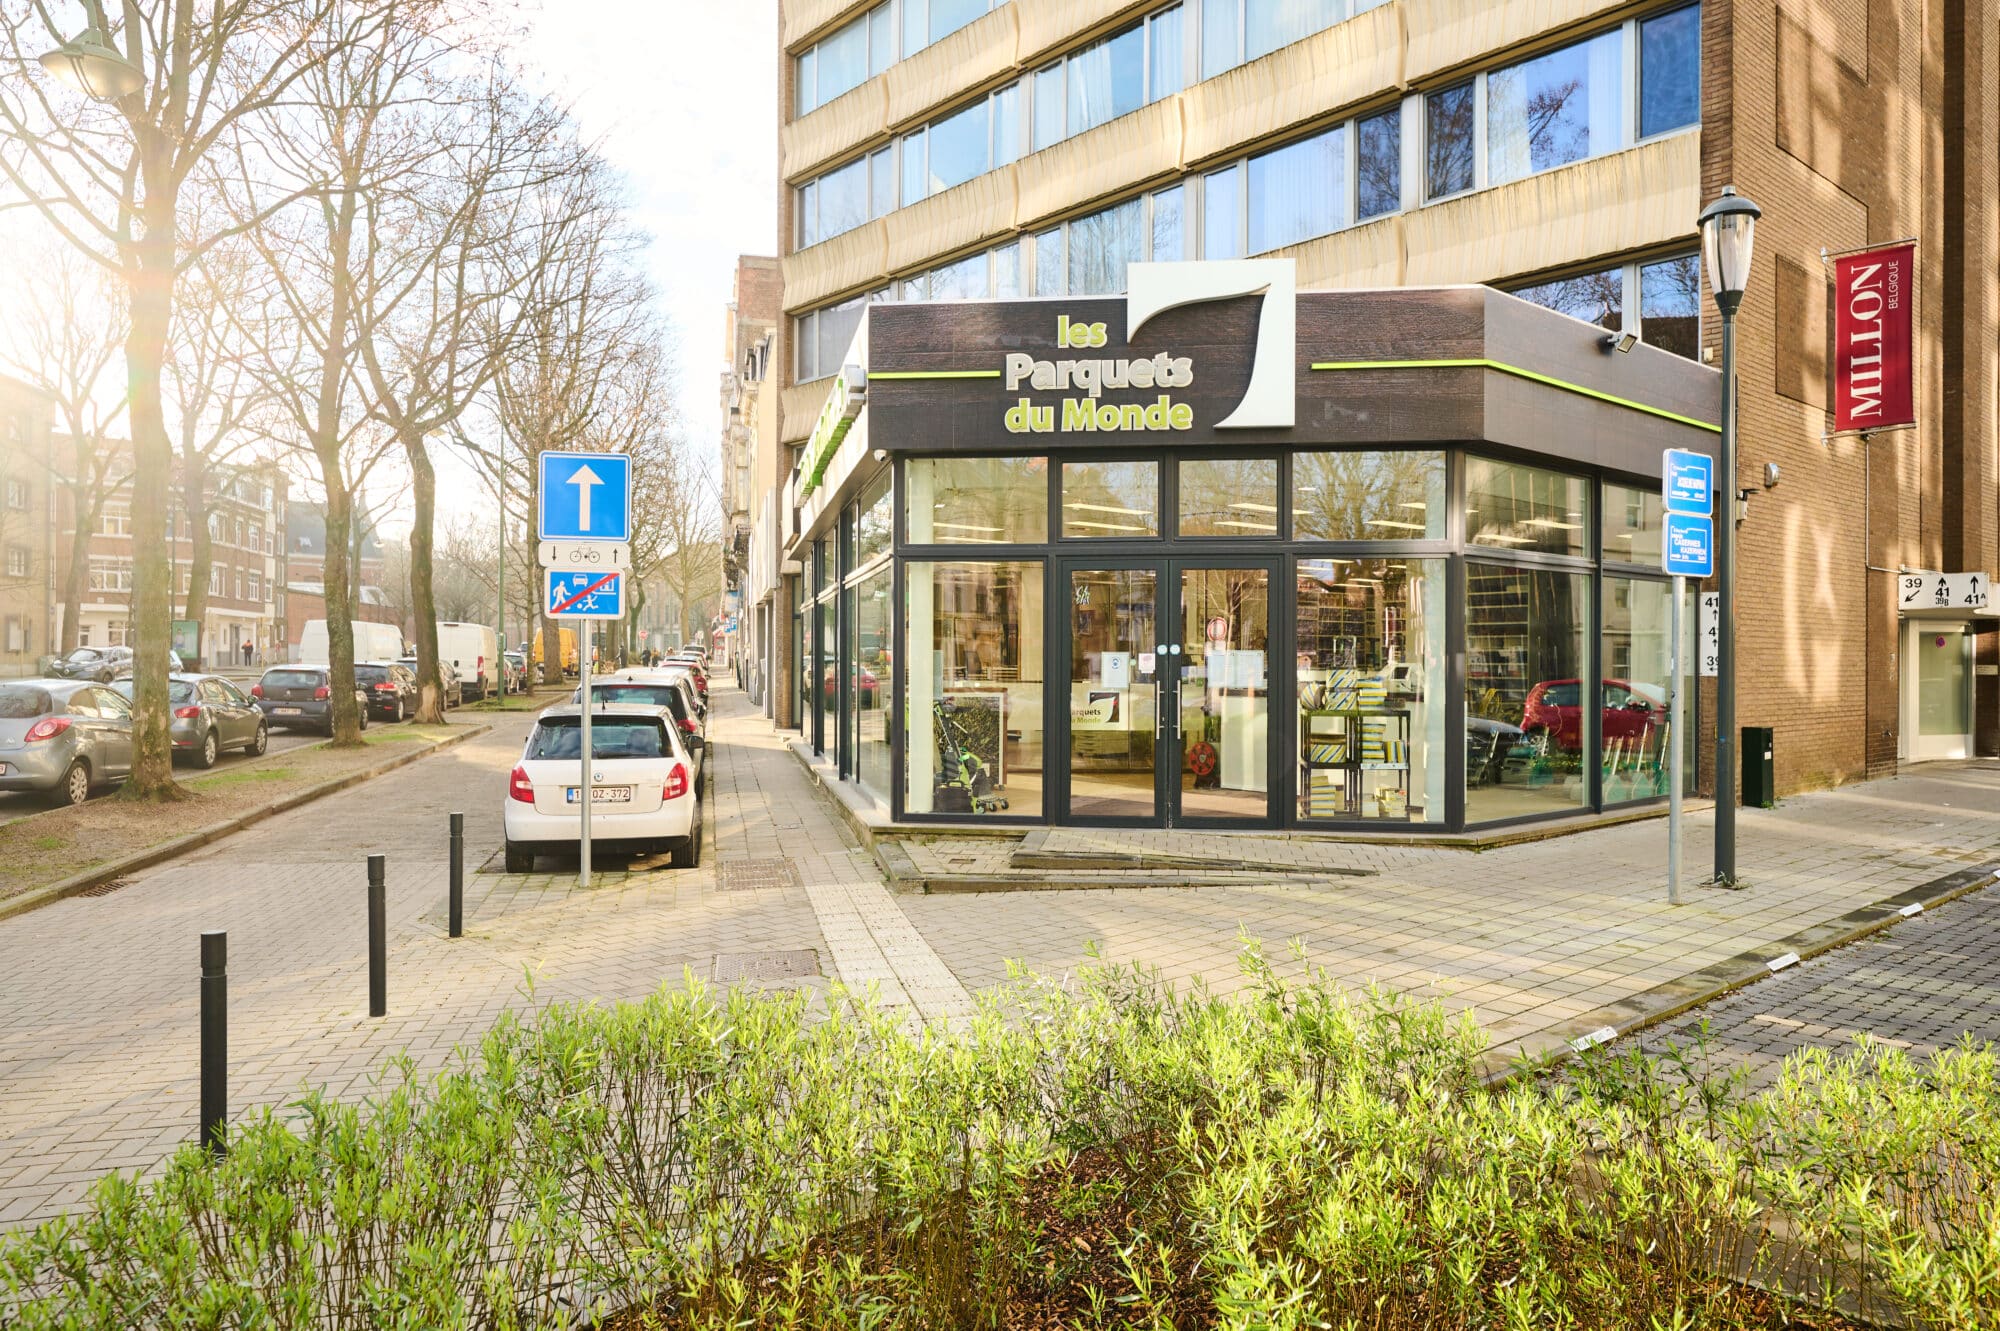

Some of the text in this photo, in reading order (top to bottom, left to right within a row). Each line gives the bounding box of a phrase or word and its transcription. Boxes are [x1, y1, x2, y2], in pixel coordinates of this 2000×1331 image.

[1888, 260, 1899, 310] BELGIQUE
[1057, 315, 1108, 349] les
[1850, 263, 1883, 421] MILLON
[1006, 351, 1194, 398] Parquets
[1004, 394, 1194, 433] du Monde
[1905, 577, 1923, 589] 39
[1935, 586, 1950, 598] 41
